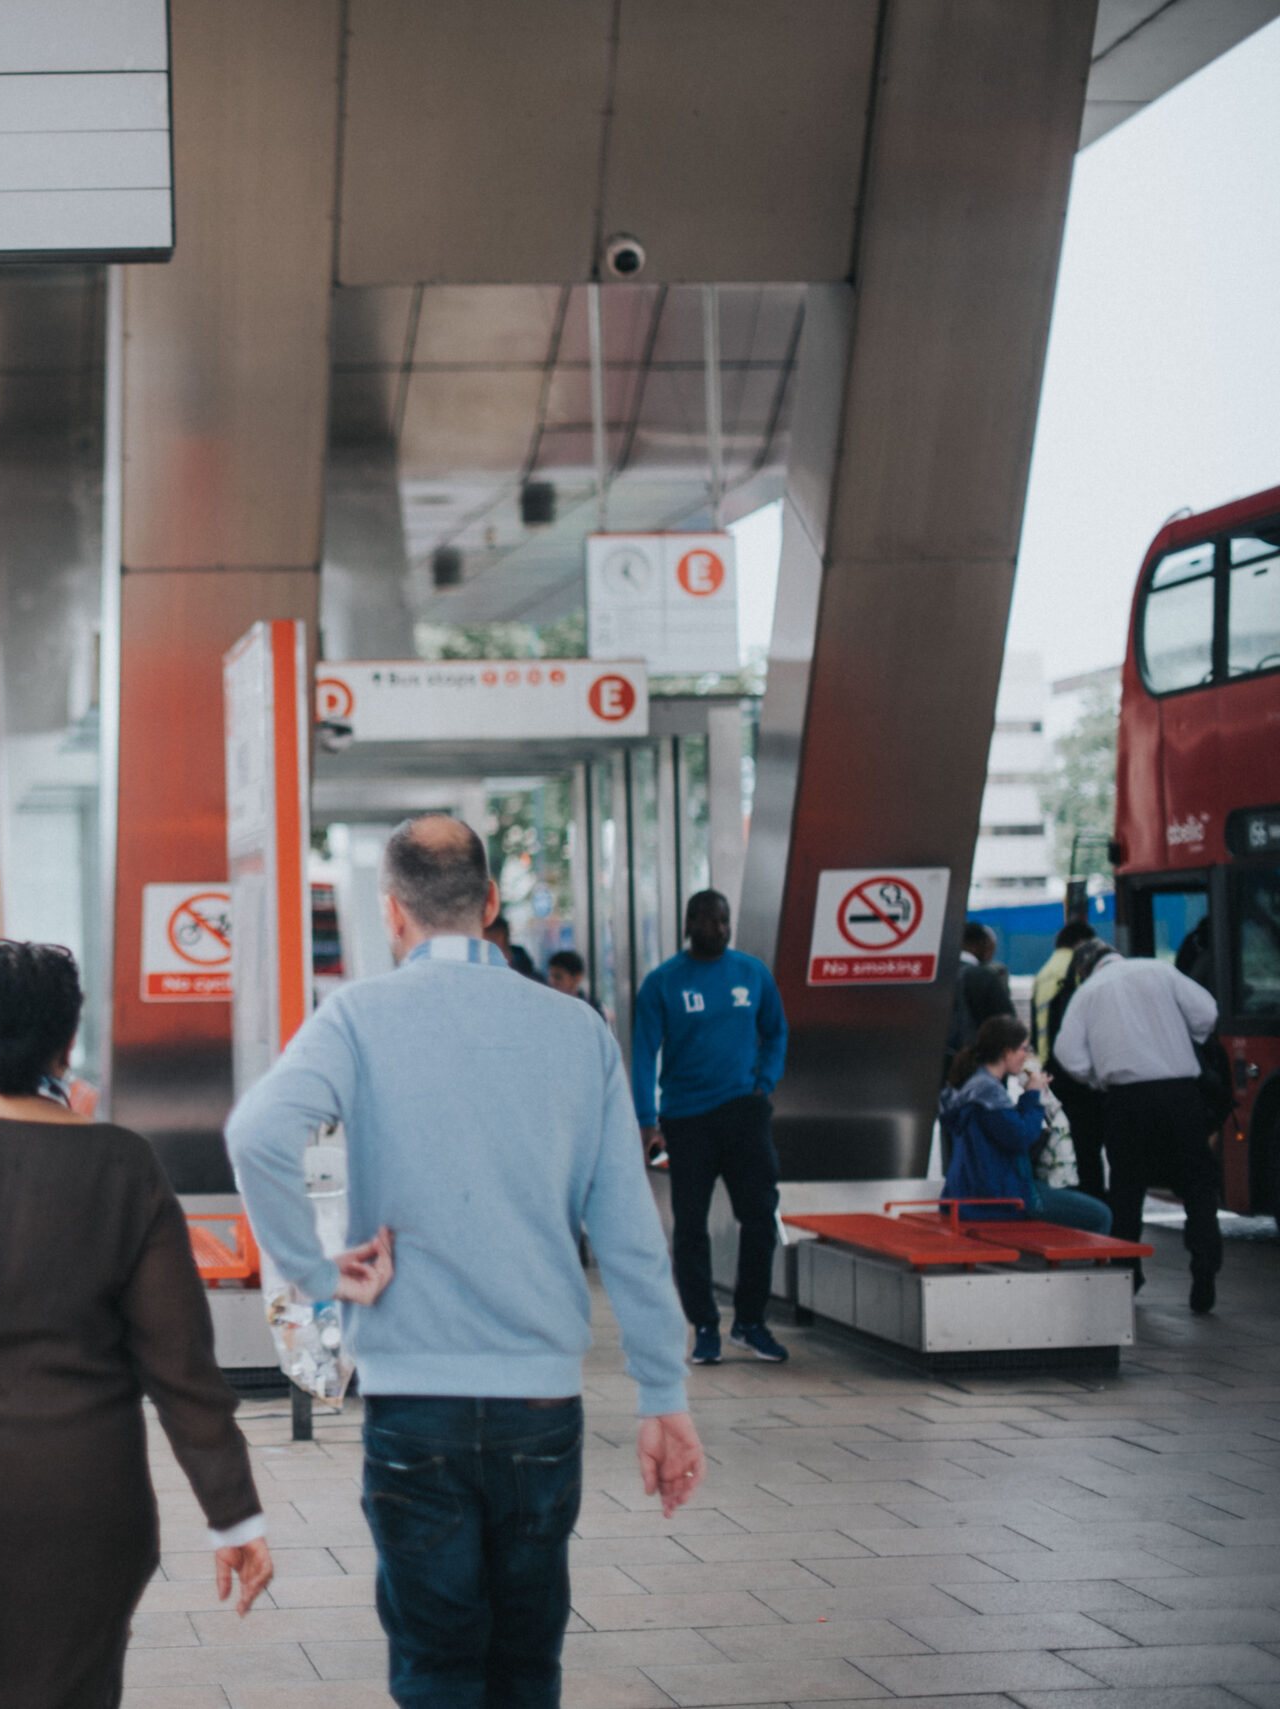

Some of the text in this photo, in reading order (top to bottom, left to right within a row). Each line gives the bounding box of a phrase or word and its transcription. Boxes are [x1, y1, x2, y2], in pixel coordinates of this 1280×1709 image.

[688, 553, 715, 592] E
[600, 679, 626, 716] E
[822, 959, 923, 978] No smoking
